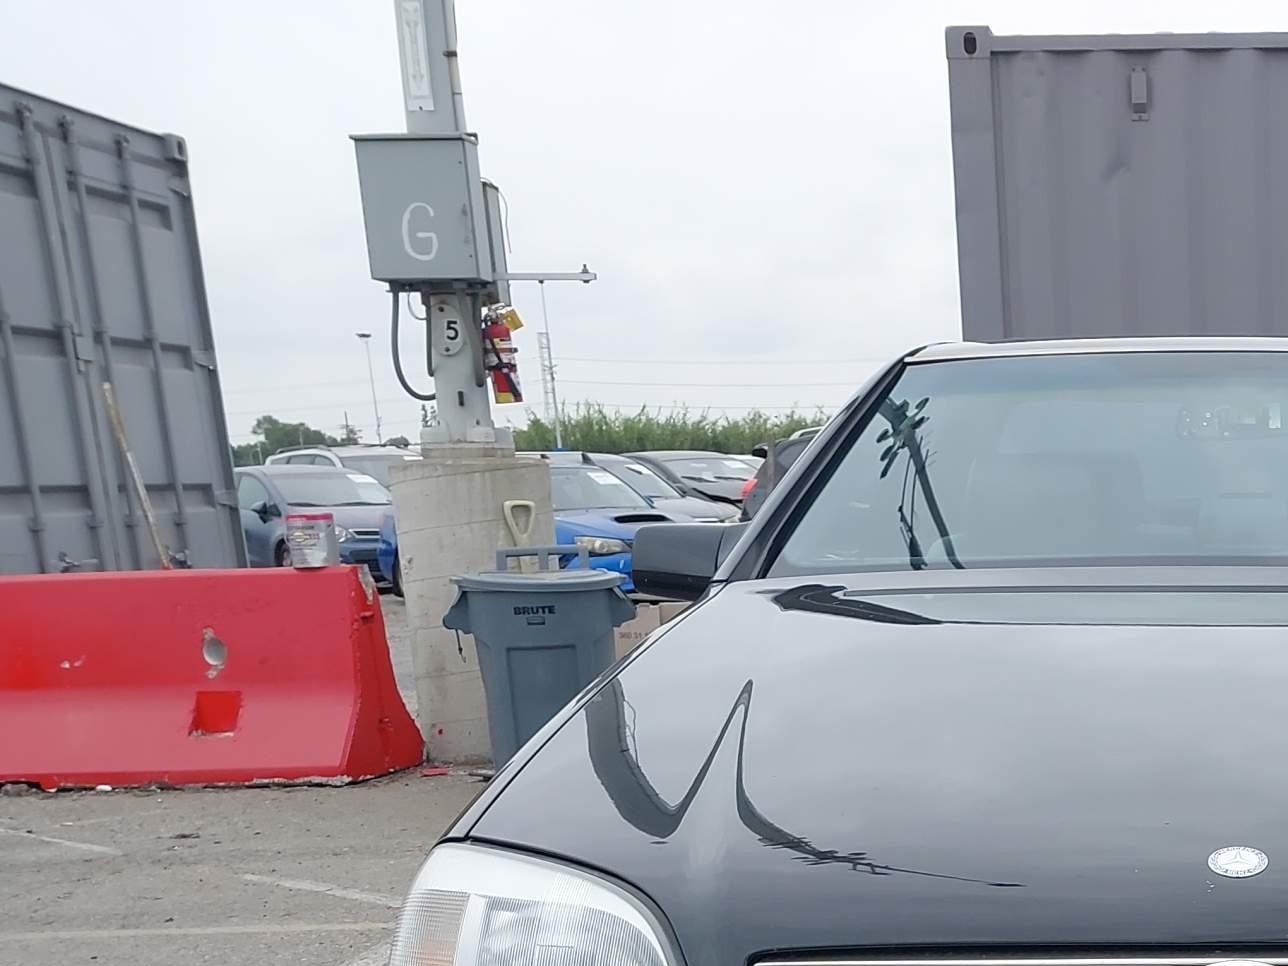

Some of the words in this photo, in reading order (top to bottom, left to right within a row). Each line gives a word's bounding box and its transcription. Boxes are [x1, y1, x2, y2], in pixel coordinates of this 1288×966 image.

[401, 202, 439, 261] G
[446, 320, 459, 341] 5
[513, 605, 556, 615] BRUTE
